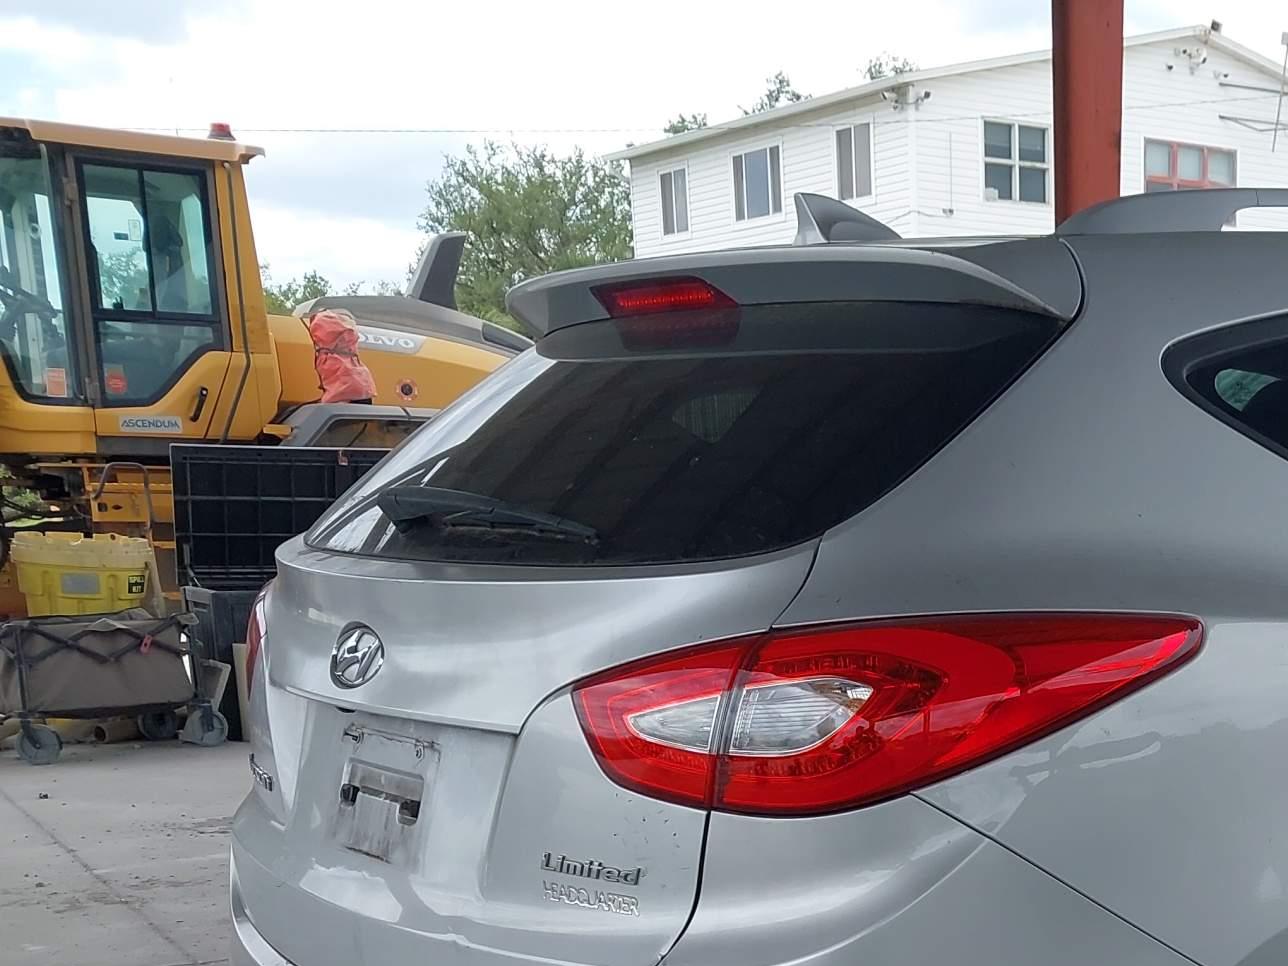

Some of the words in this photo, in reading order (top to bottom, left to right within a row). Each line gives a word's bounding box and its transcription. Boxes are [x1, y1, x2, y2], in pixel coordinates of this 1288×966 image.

[358, 332, 415, 348] OLVO
[121, 418, 180, 429] ASCENDUM
[541, 852, 641, 886] Limited
[542, 879, 641, 917] HEADQUARTER
